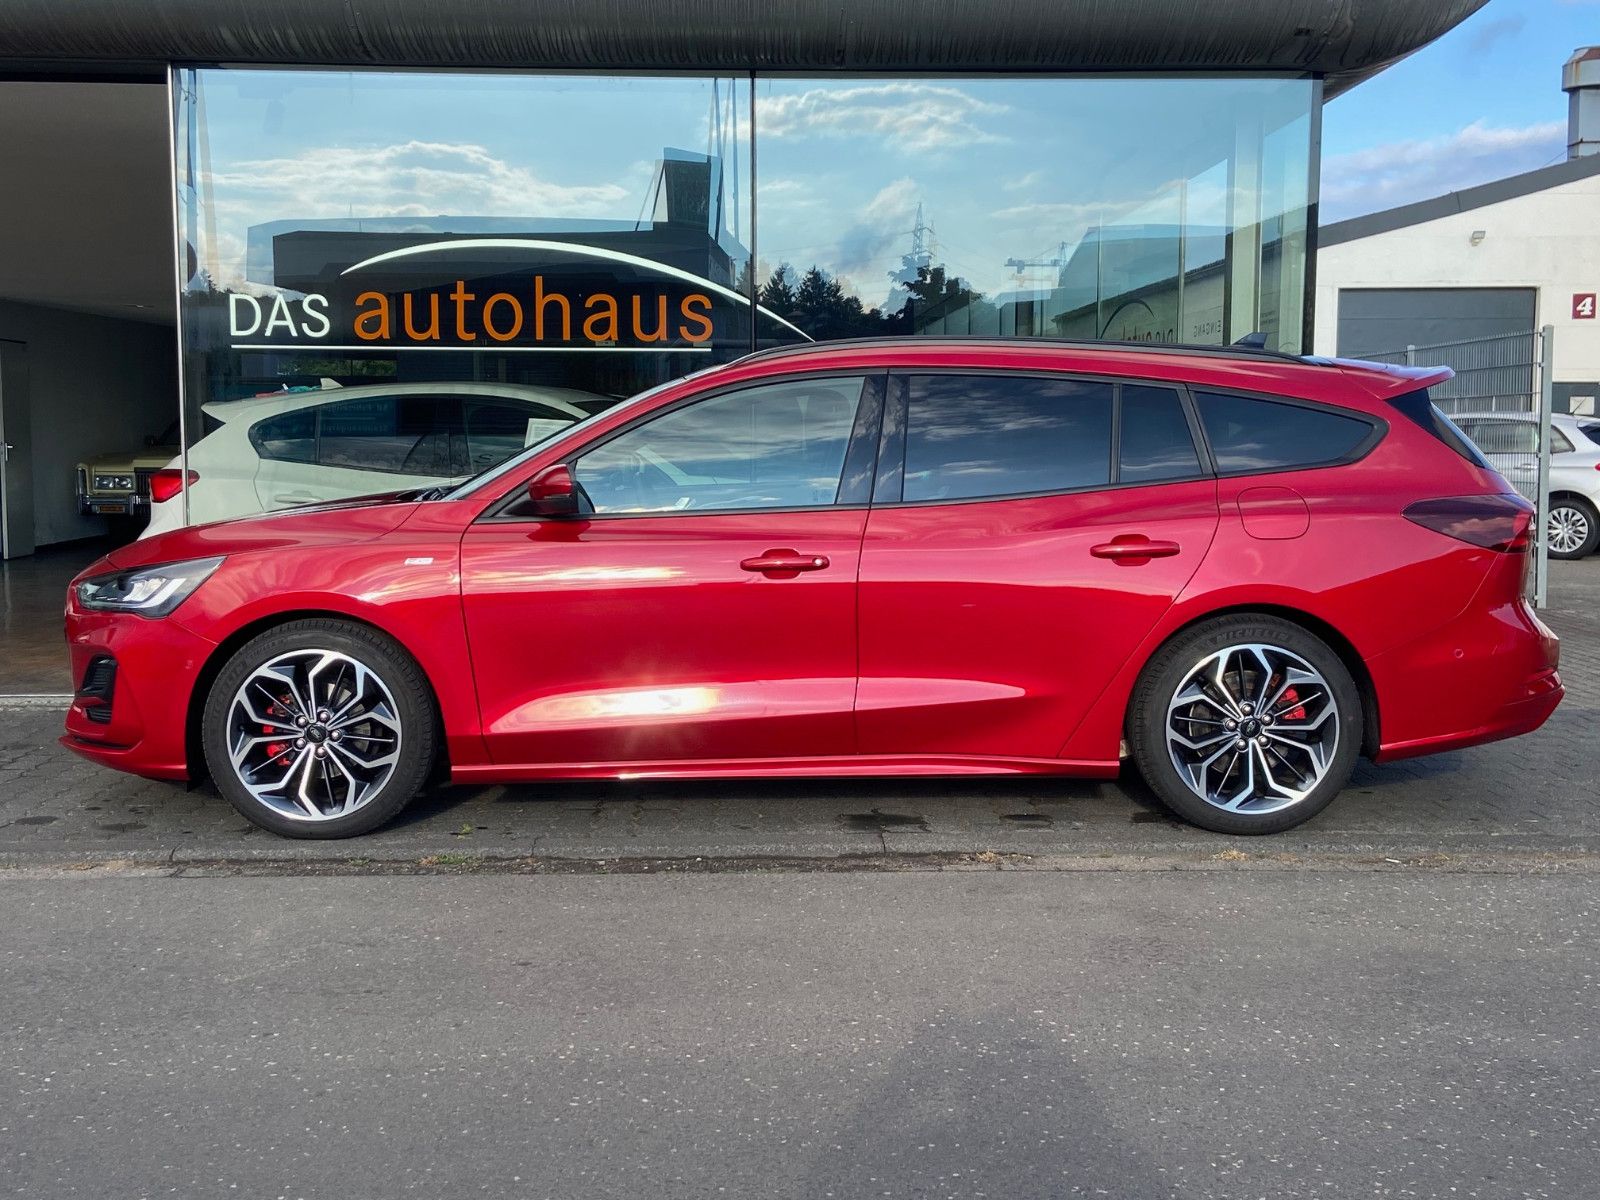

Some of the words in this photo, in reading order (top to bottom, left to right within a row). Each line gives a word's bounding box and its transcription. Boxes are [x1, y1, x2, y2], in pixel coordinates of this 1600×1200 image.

[229, 293, 331, 338] DAS
[354, 275, 713, 343] autohaus
[1576, 296, 1593, 316] 4
